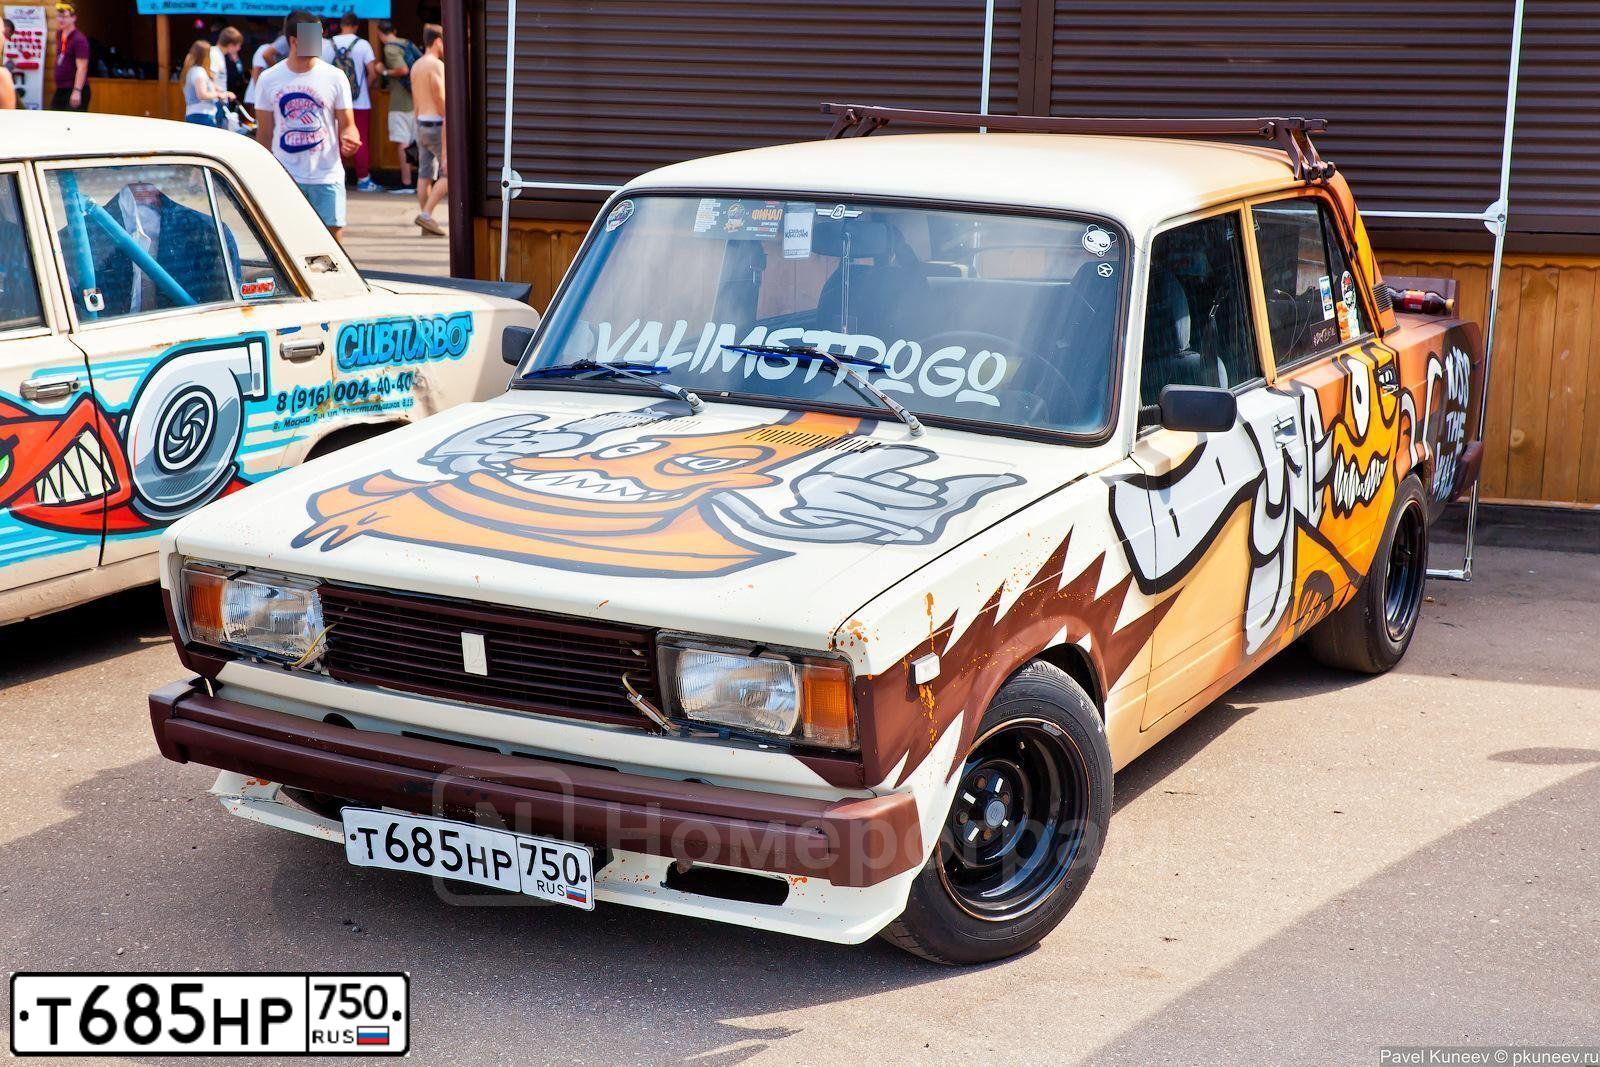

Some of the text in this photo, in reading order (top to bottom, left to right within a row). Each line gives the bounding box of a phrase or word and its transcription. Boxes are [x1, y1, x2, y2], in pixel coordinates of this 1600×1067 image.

[338, 313, 473, 370] CLUBTURBO
[598, 318, 1008, 406] VALIMSTROGO
[276, 372, 414, 412] 8 (916) 004-40-40
[1446, 411, 1467, 443] THE
[357, 822, 581, 886] Т685НР 750
[536, 879, 565, 897] RUS
